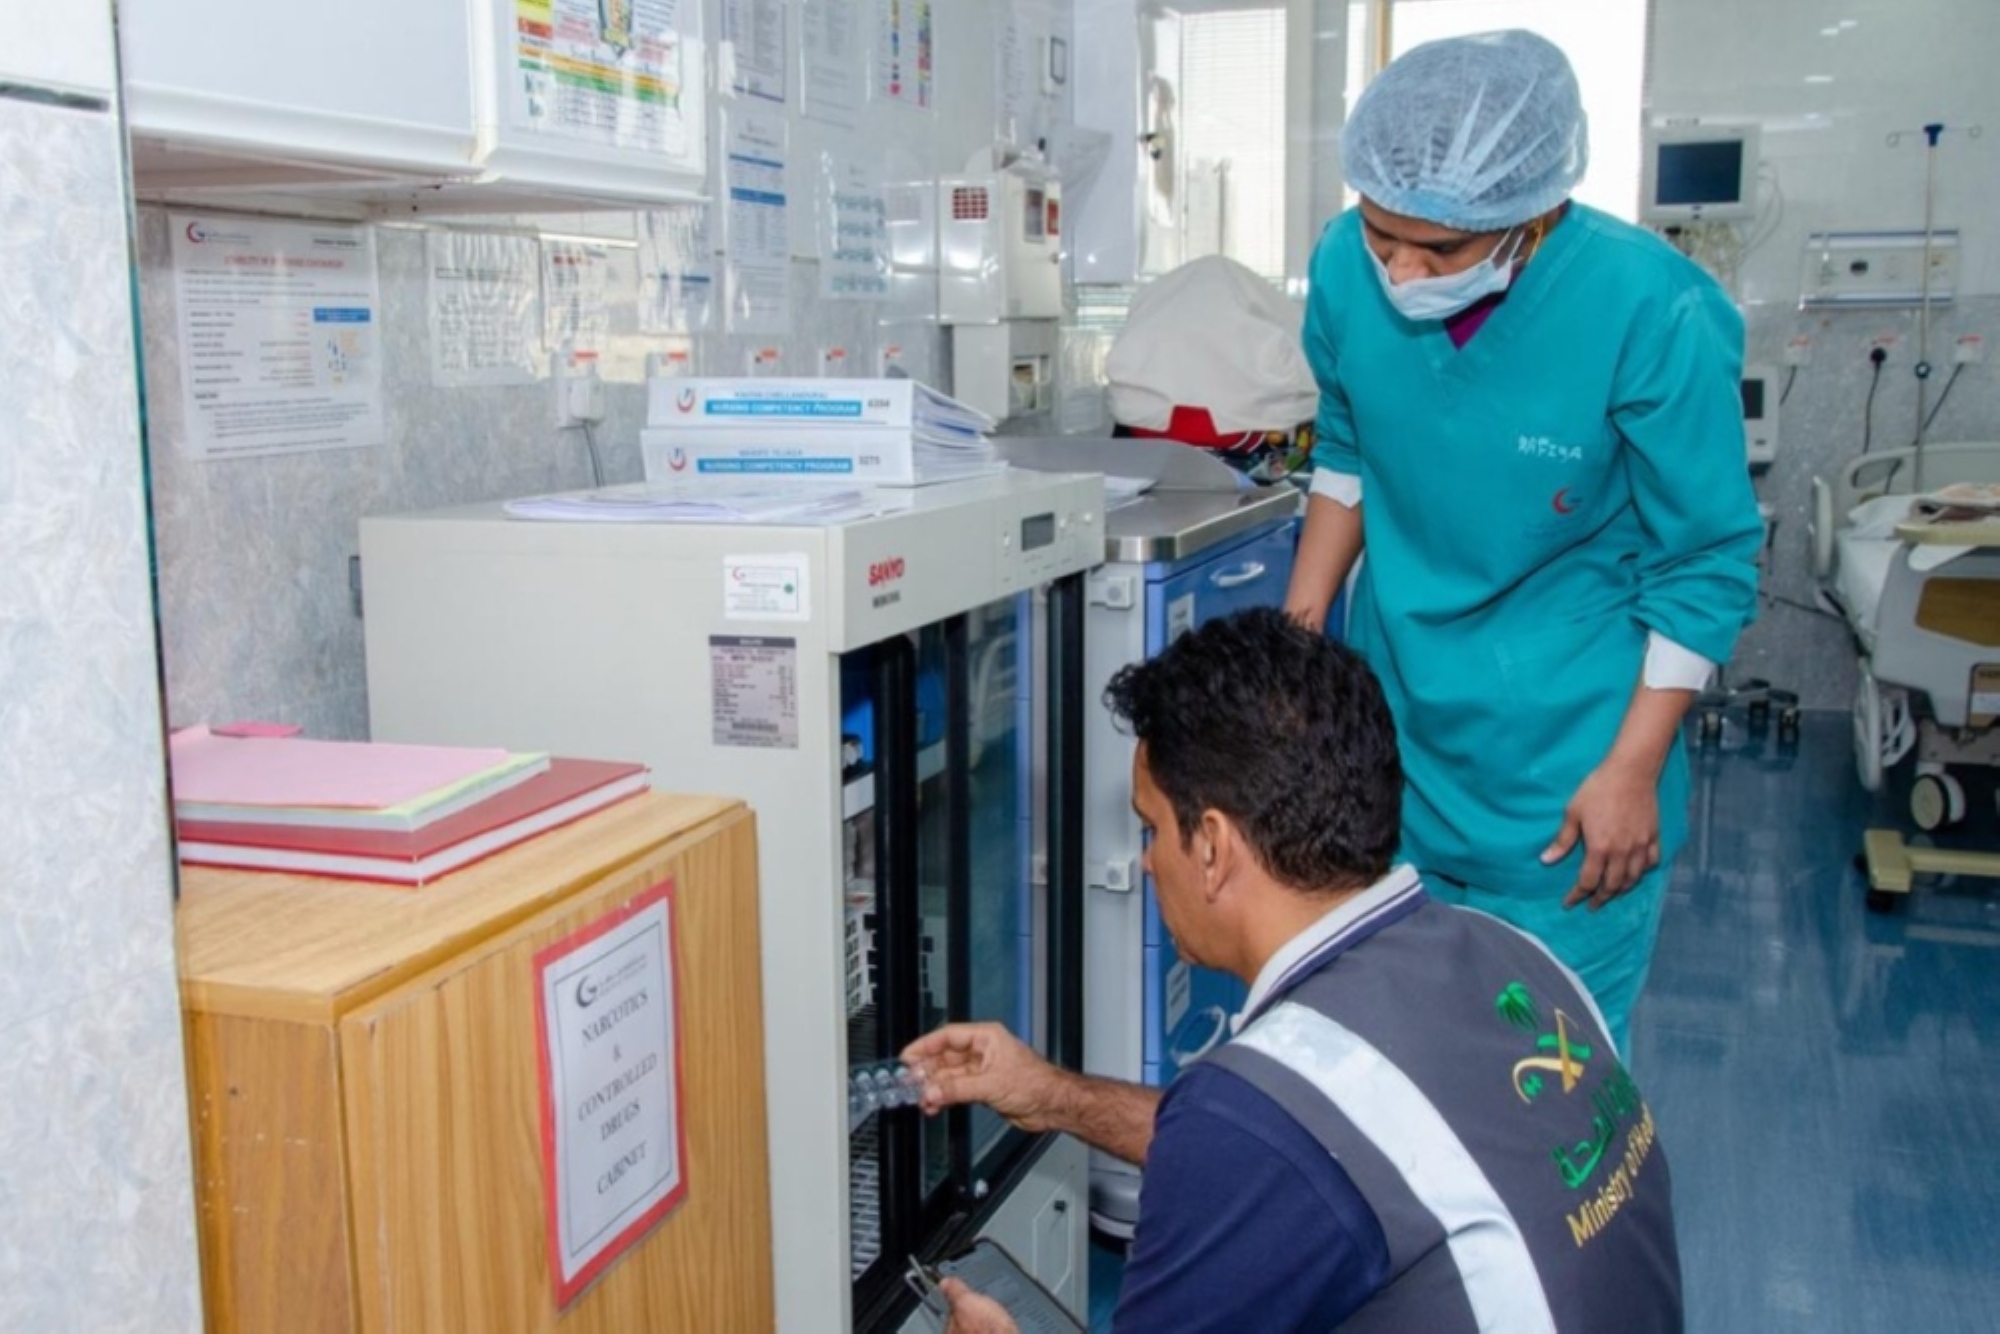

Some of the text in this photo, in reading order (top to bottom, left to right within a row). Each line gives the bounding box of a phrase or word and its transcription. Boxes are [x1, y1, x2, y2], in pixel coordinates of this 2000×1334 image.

[751, 403, 811, 413] COMPETENCY
[813, 404, 858, 414] PROGRAM
[744, 461, 801, 471] COMPETENCY
[803, 461, 850, 471] PROGRAM
[868, 556, 906, 588] SANYO
[582, 987, 648, 1044] NARCOTICS
[578, 1052, 658, 1122] CONTROLLED
[601, 1098, 641, 1142] DRUGS
[1566, 1162, 1634, 1247] Ministry
